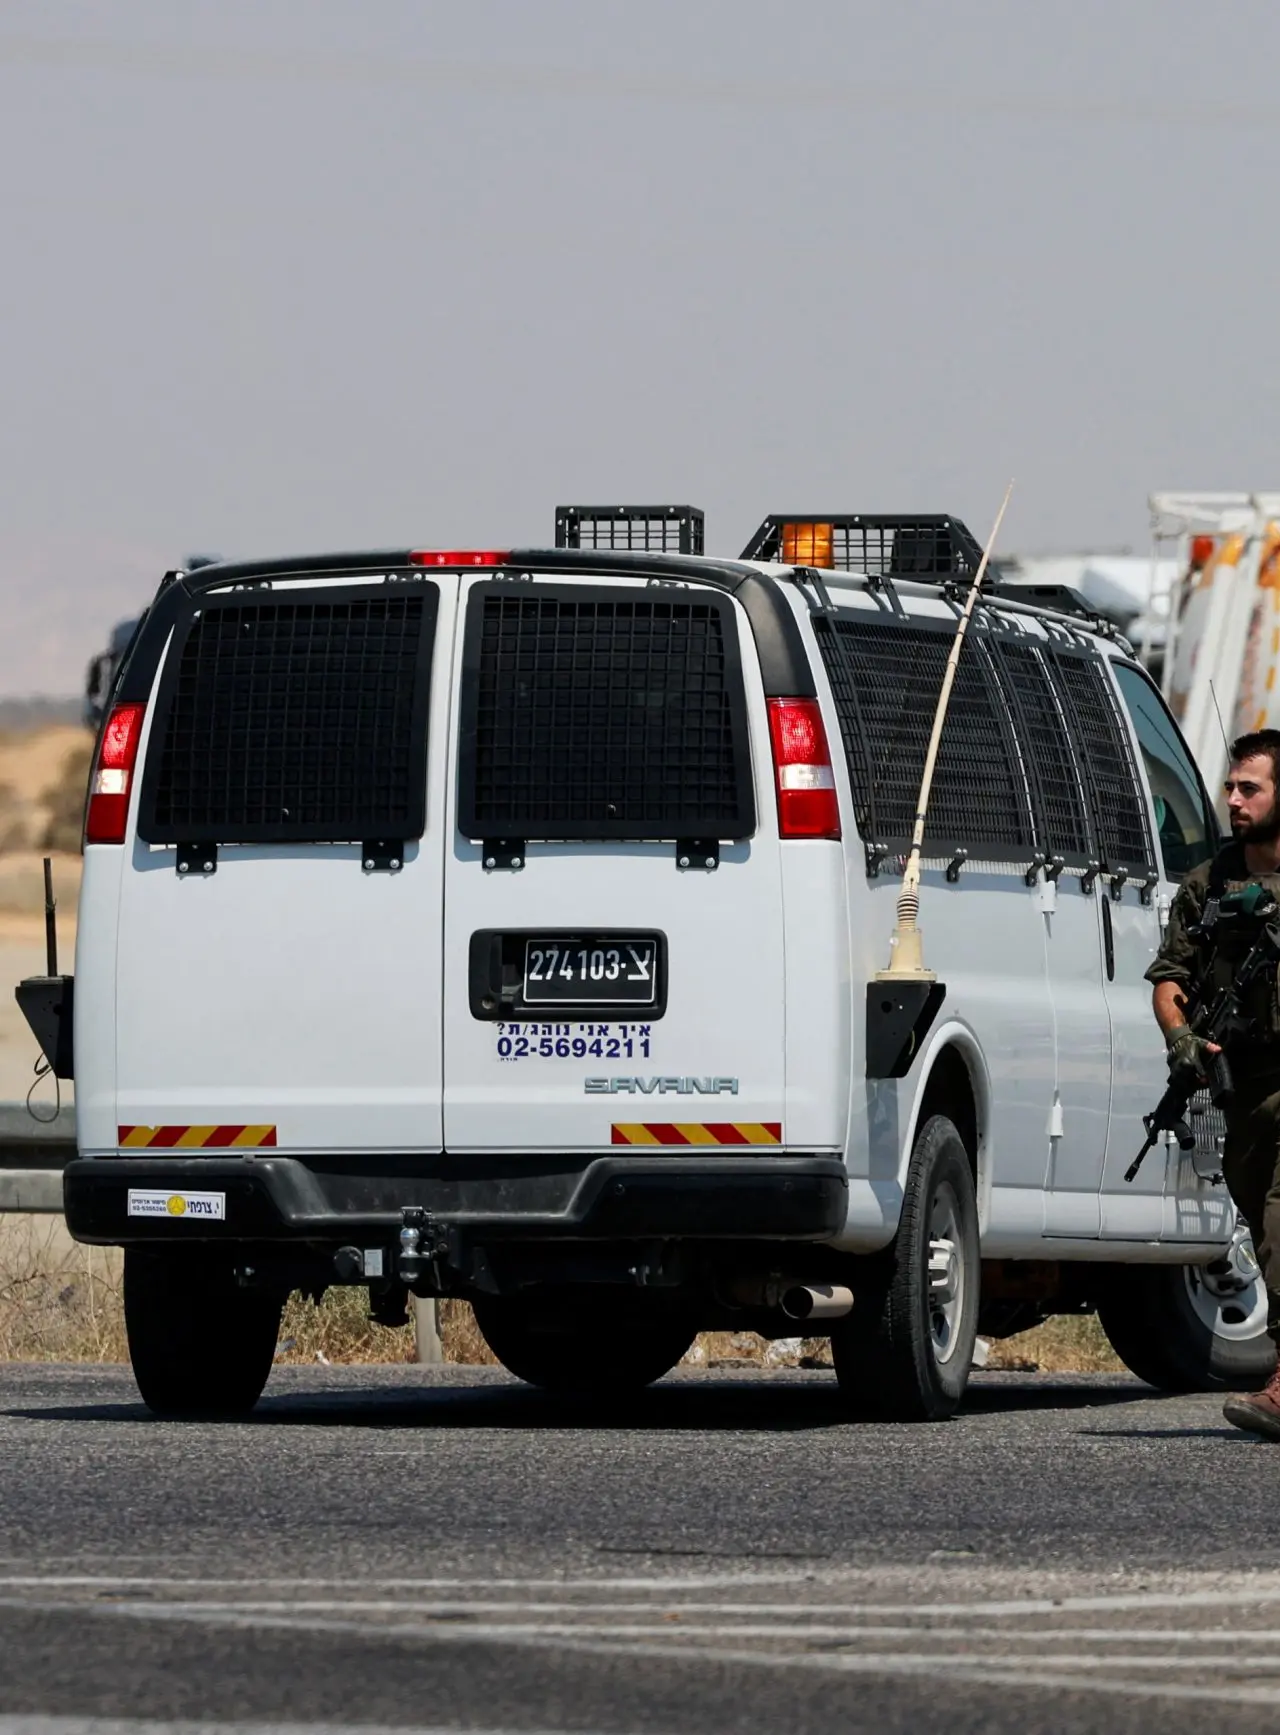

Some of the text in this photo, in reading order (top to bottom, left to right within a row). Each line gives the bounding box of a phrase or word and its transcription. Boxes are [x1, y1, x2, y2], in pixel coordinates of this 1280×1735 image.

[579, 1024, 609, 1037] אני
[618, 1024, 651, 1039] איך
[497, 1037, 651, 1058] 02-5694211
[584, 1076, 739, 1095] SAVANA
